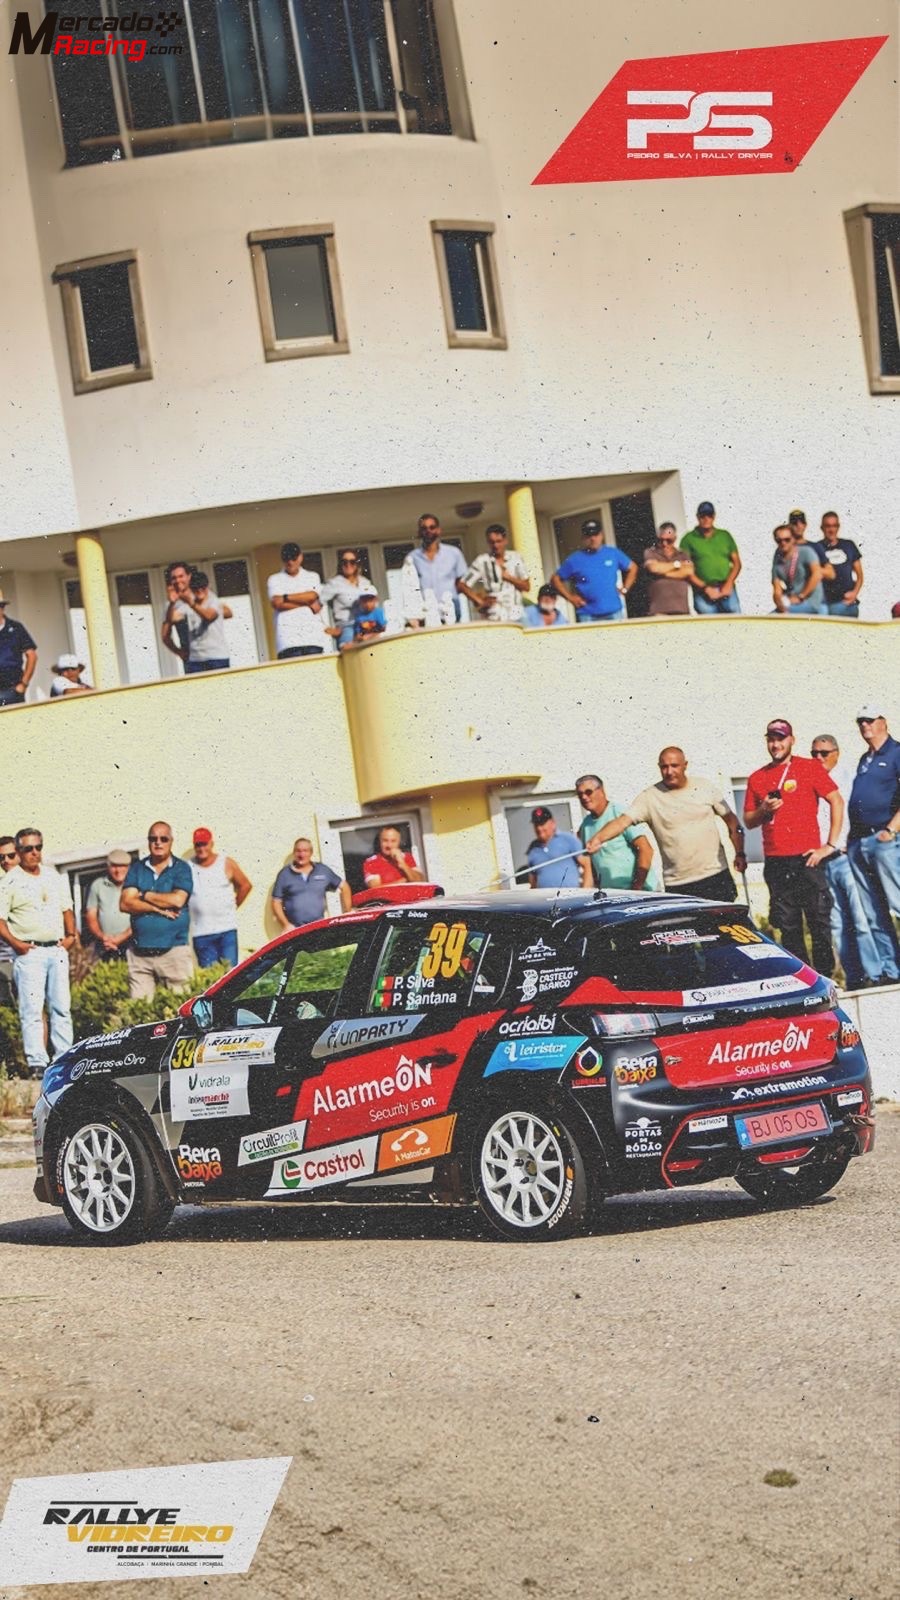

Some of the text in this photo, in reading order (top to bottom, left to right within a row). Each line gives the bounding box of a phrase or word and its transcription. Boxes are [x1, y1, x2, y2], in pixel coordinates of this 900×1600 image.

[718, 924, 763, 944] 39
[422, 922, 468, 979] 39
[394, 975, 435, 989] P. Silva
[392, 991, 457, 1006] P. Santana
[171, 1038, 198, 1069] 39
[87, 1058, 114, 1070] Terras
[735, 1062, 769, 1077] Security
[771, 1062, 779, 1071] is
[199, 1075, 231, 1088] vidrala
[754, 1075, 827, 1096] extramotion
[369, 1103, 410, 1122] Security
[411, 1099, 420, 1111] is
[750, 1120, 771, 1138] BJ
[773, 1114, 793, 1133] 05
[794, 1109, 818, 1129] OS
[624, 1129, 662, 1138] PORTAS
[178, 1144, 221, 1163] Beira
[625, 1142, 662, 1153] RÓDÃO
[177, 1155, 223, 1181] baixa
[303, 1149, 366, 1181] Castrol
[394, 1154, 400, 1163] A
[547, 1179, 574, 1229] HANKOOK
